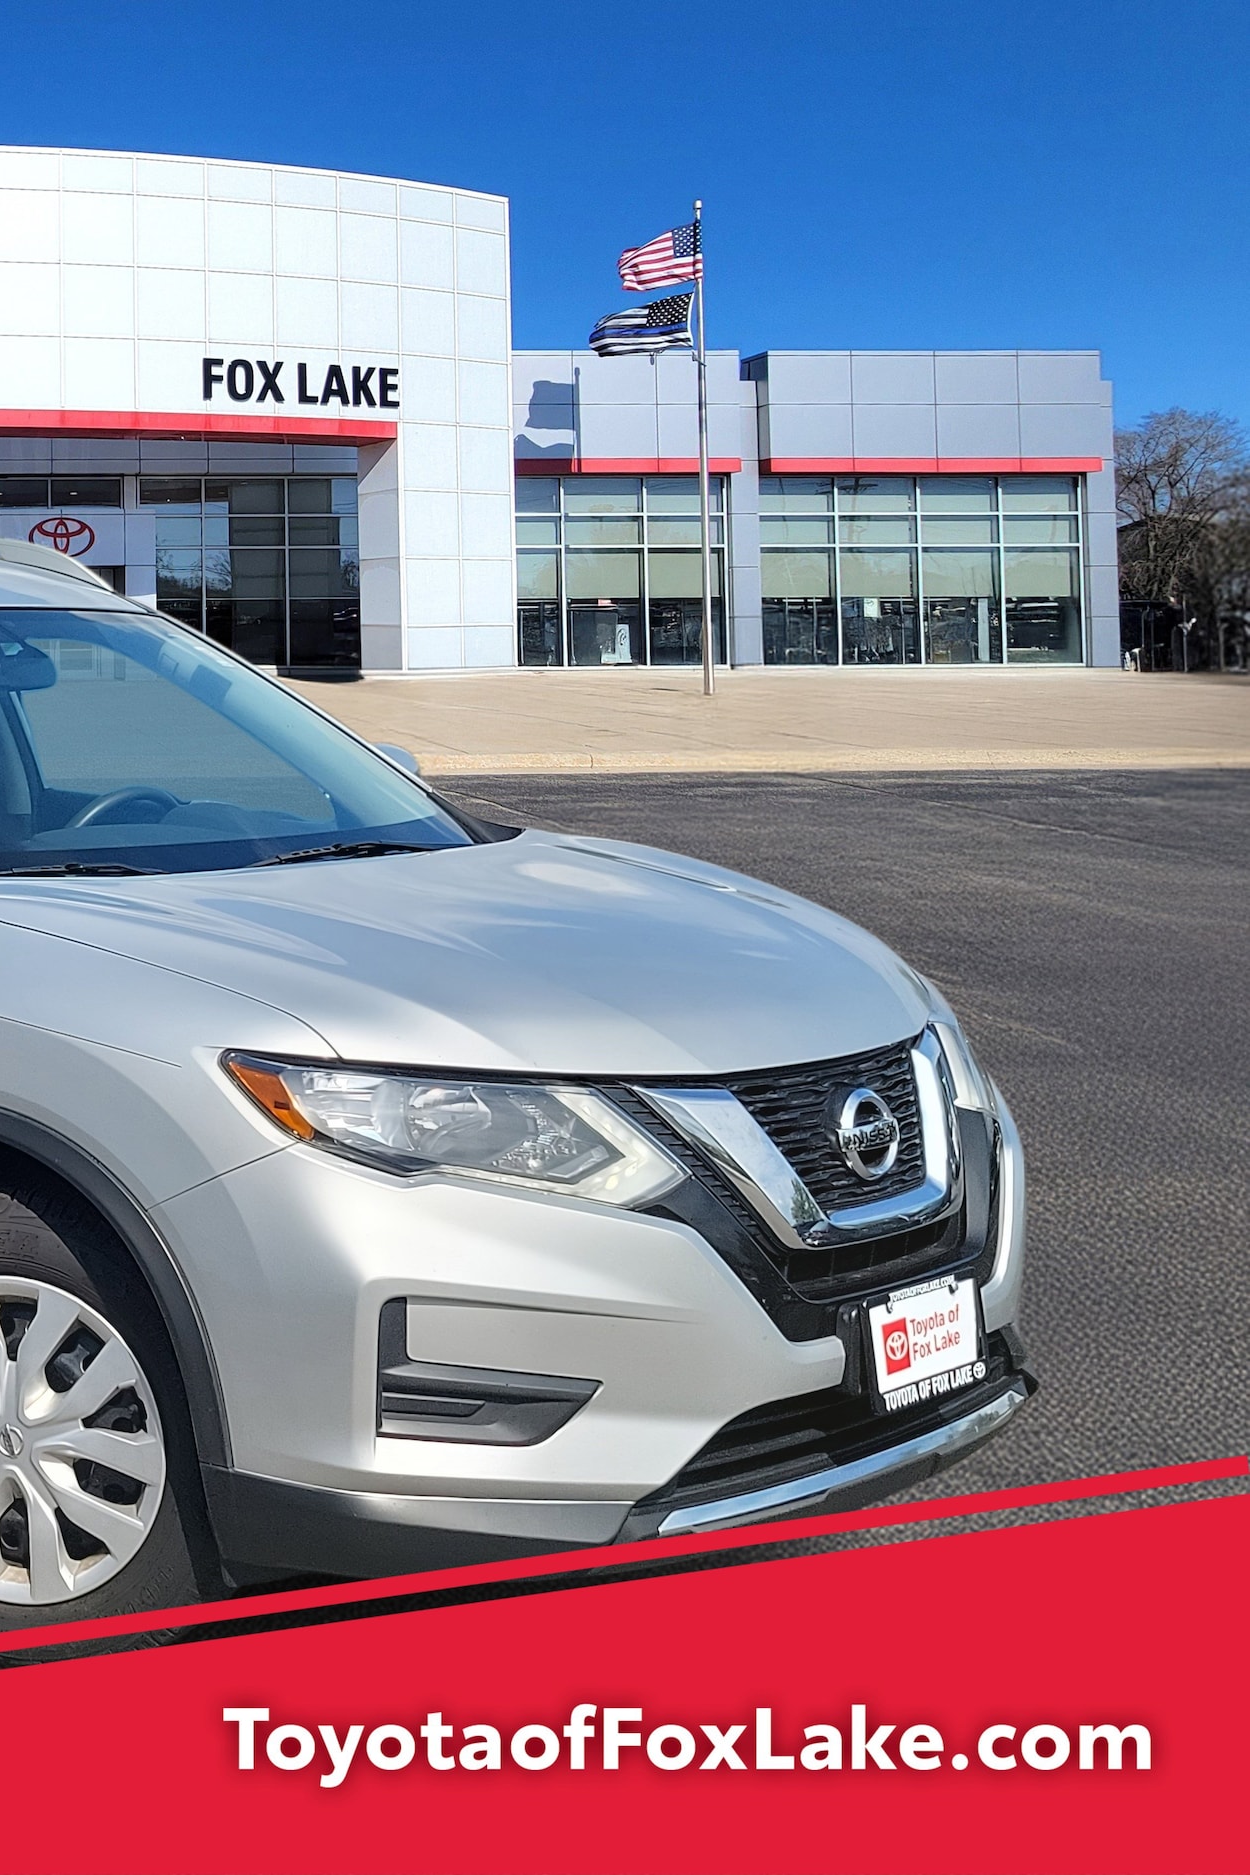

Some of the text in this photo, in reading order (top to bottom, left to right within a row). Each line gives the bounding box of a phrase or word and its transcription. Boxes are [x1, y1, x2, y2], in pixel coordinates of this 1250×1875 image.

[203, 358, 401, 408] FOX LAKE
[910, 1303, 959, 1337] Toyota of
[912, 1330, 960, 1361] Fox Lake
[883, 1364, 974, 1411] TOYOTA OF FOX LAKE
